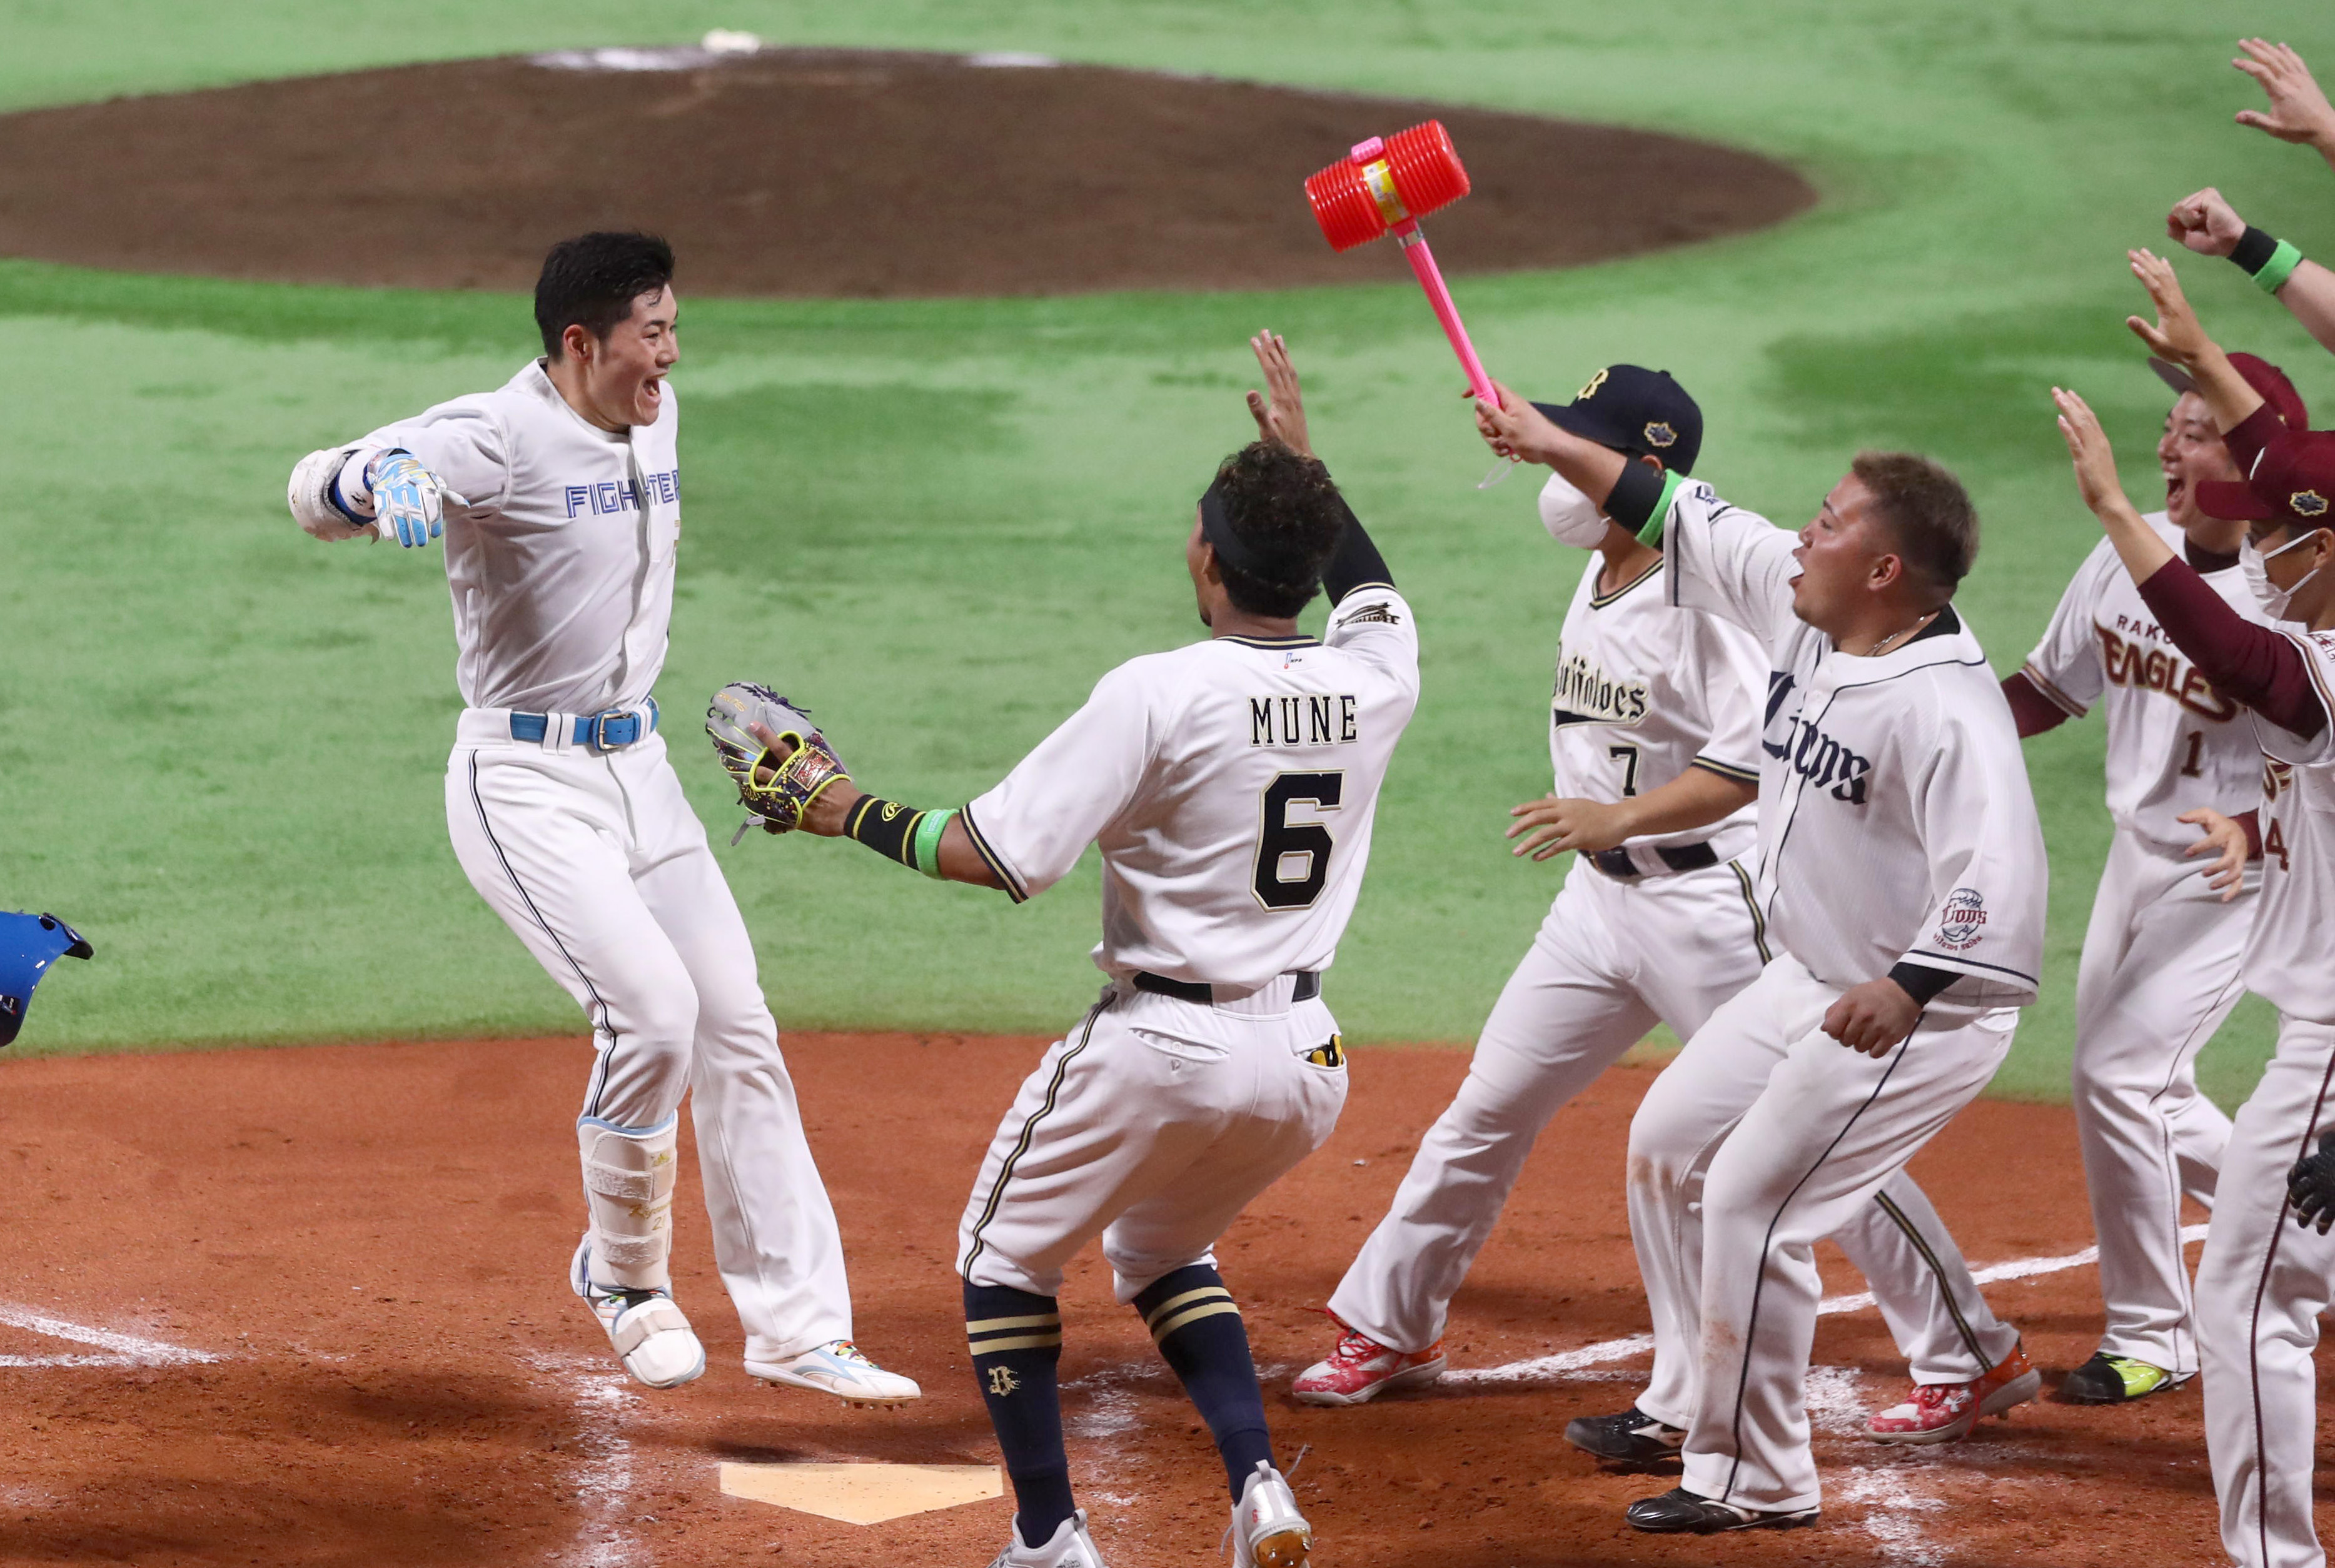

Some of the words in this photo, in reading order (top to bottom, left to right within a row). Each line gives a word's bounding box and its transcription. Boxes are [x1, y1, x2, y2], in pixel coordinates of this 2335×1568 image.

[1248, 694, 1358, 747] MUNE
[1608, 742, 1641, 799] 7
[2180, 730, 2204, 779] 1
[1250, 769, 1346, 913] 6
